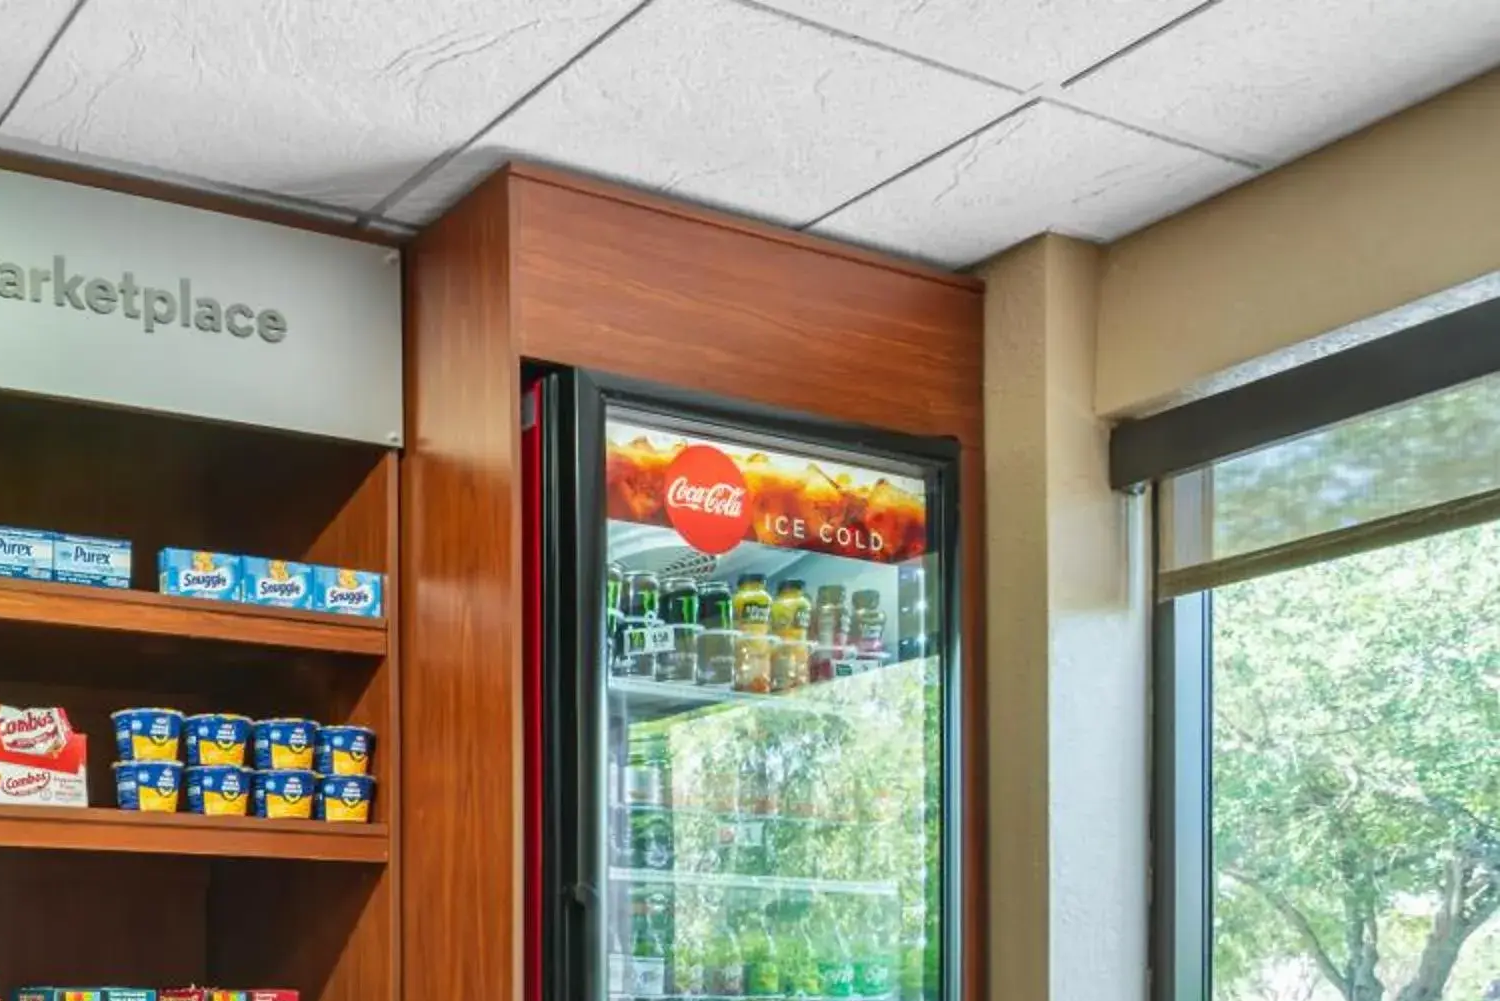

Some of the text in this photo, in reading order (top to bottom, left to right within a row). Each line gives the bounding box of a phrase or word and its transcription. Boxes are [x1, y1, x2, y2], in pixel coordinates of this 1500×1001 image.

[667, 476, 746, 518] Coca-Cola
[764, 514, 884, 552] ICE COLD
[73, 545, 112, 565] Purex
[183, 573, 227, 588] Snuggle
[259, 581, 301, 597] Snuggle
[328, 590, 369, 605] Snuggle
[5, 771, 47, 790] Combos
